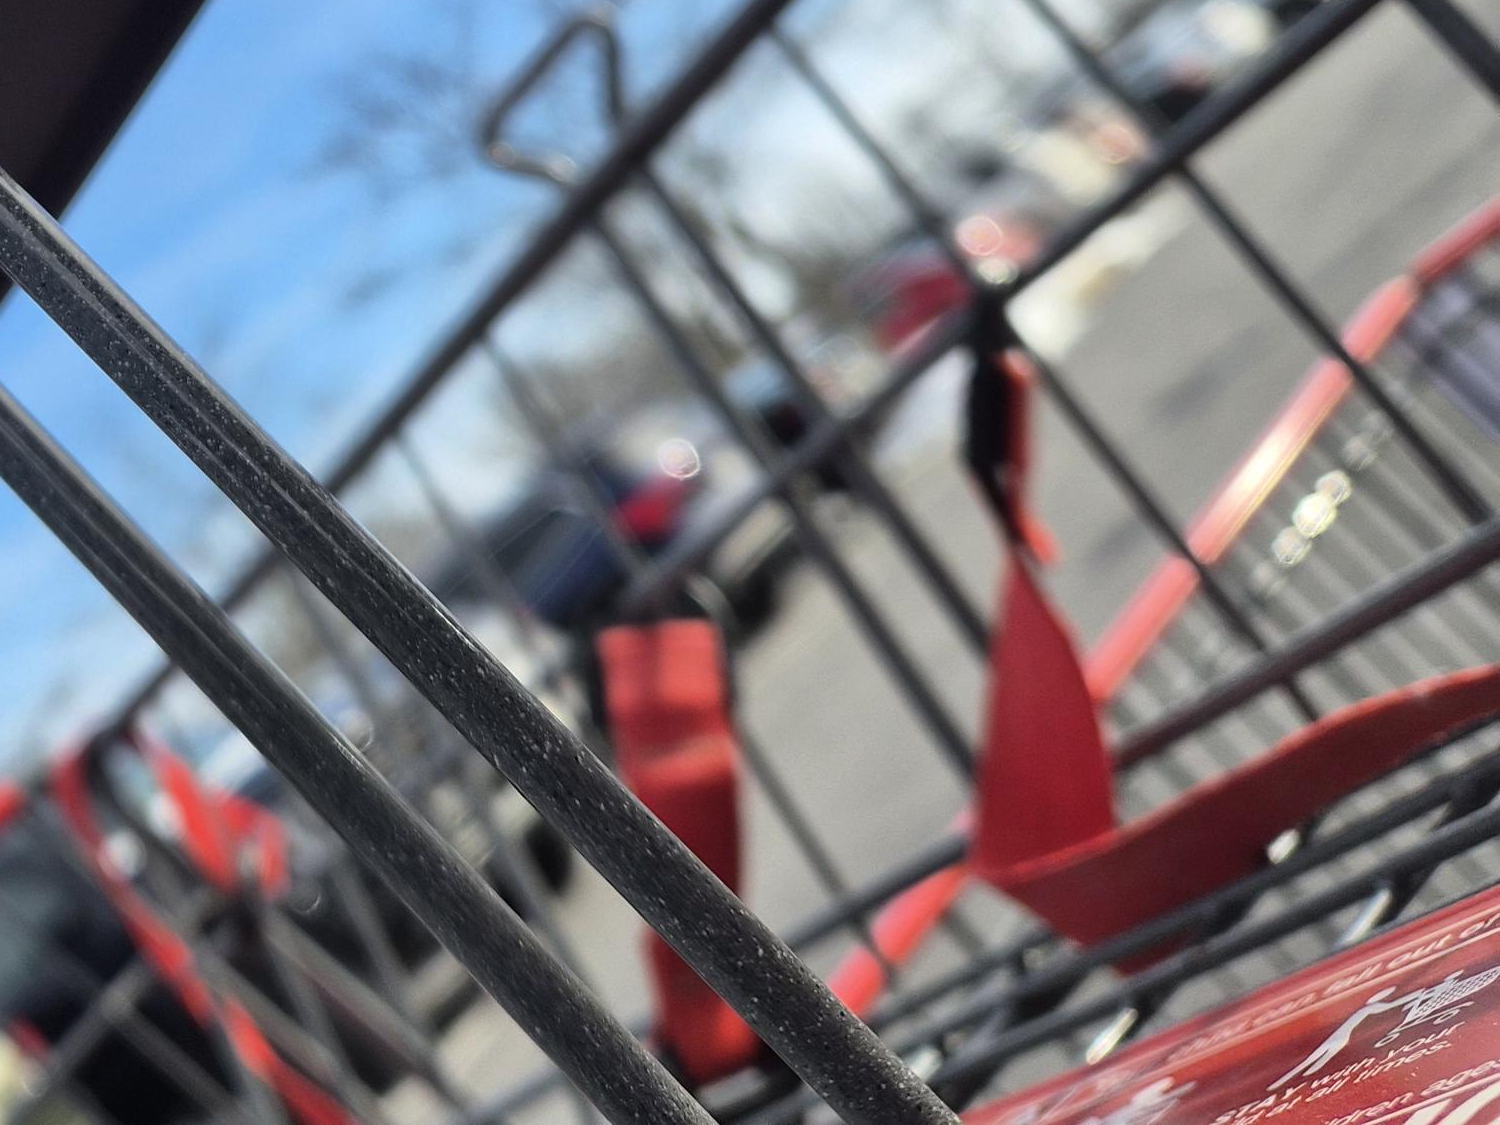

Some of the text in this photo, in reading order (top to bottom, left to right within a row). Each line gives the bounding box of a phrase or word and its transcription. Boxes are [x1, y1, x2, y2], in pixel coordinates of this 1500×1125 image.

[1322, 962, 1384, 997] fall
[1386, 934, 1452, 969] out
[1208, 1021, 1466, 1125] STAY with your
[1264, 1095, 1302, 1118] at
[1305, 1076, 1351, 1103] all
[1353, 1041, 1452, 1084] times.
